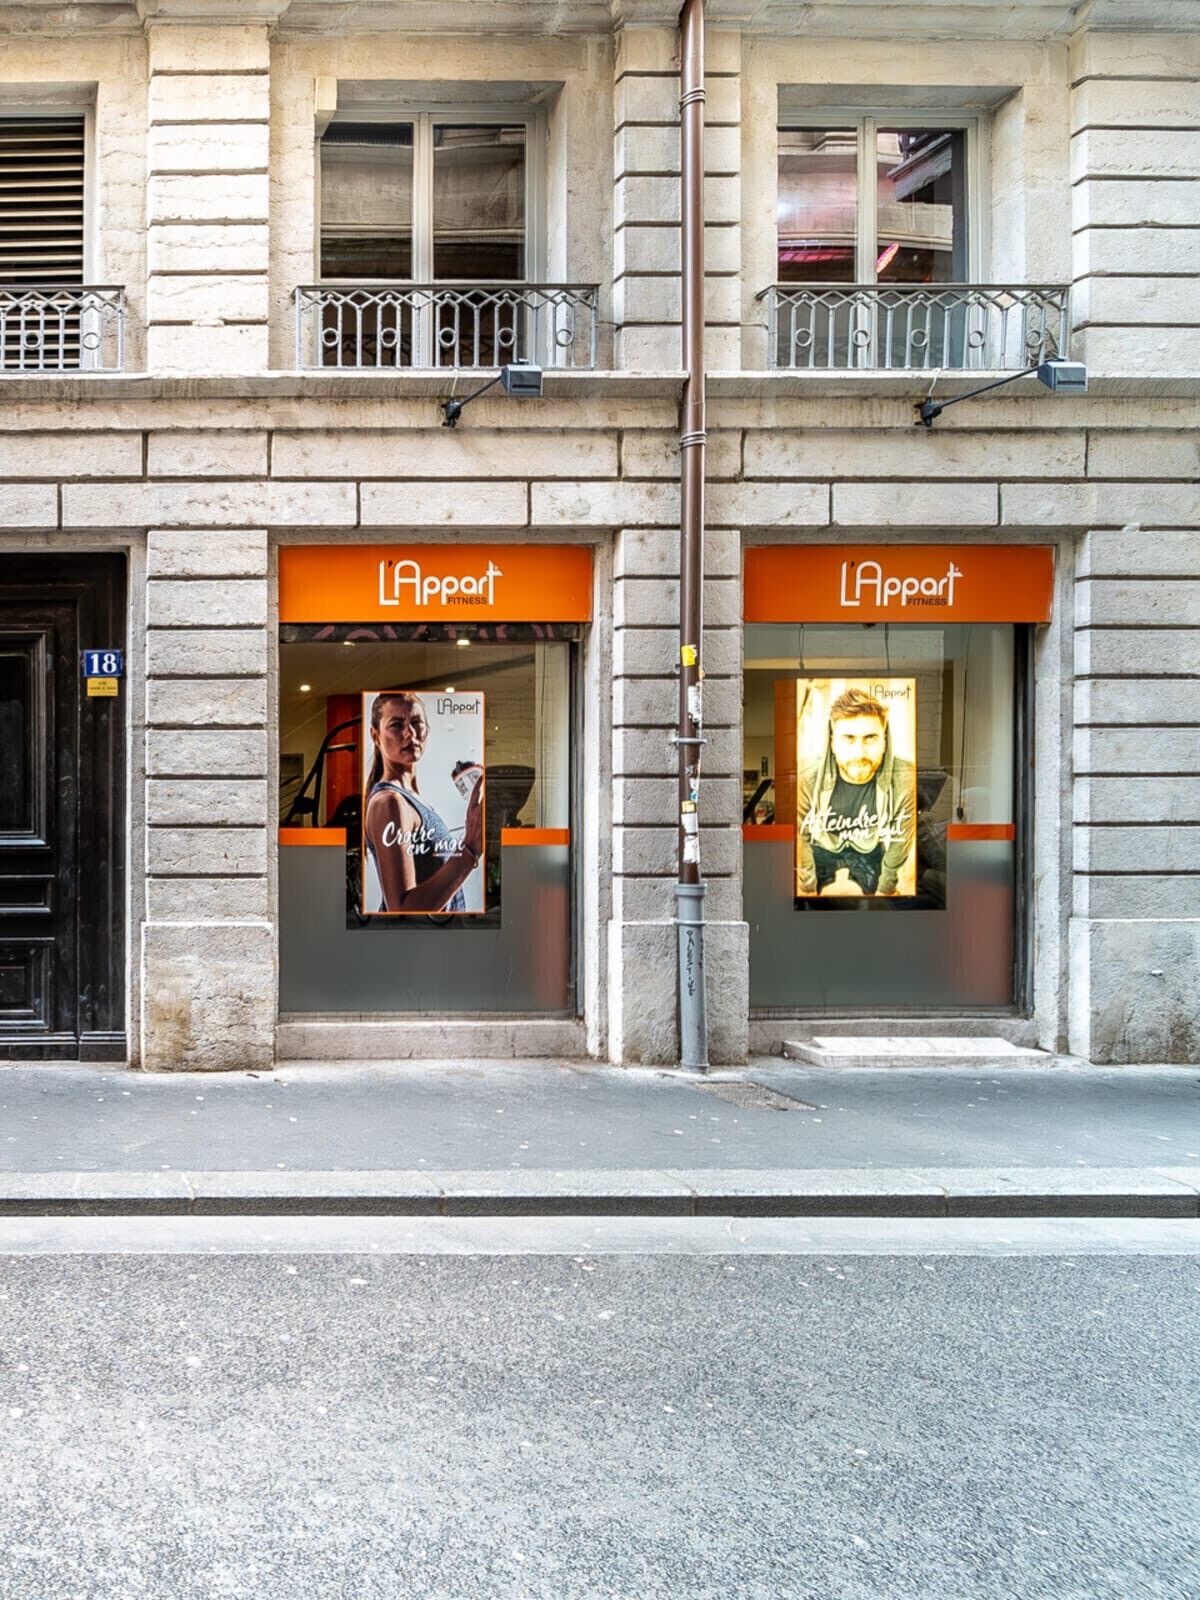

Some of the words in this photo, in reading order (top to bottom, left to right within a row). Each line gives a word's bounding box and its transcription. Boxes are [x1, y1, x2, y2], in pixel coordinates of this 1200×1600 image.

[378, 559, 504, 606] L'Appart
[840, 560, 964, 606] L'Appart
[447, 596, 487, 605] FITNESS
[908, 597, 947, 606] FITNESS
[90, 653, 117, 674] 18
[869, 684, 912, 701] LAppart
[381, 821, 436, 847] Croire
[799, 805, 879, 844] Atteindre
[838, 828, 874, 840] mon
[406, 843, 431, 857] en
[434, 834, 466, 853] moi
